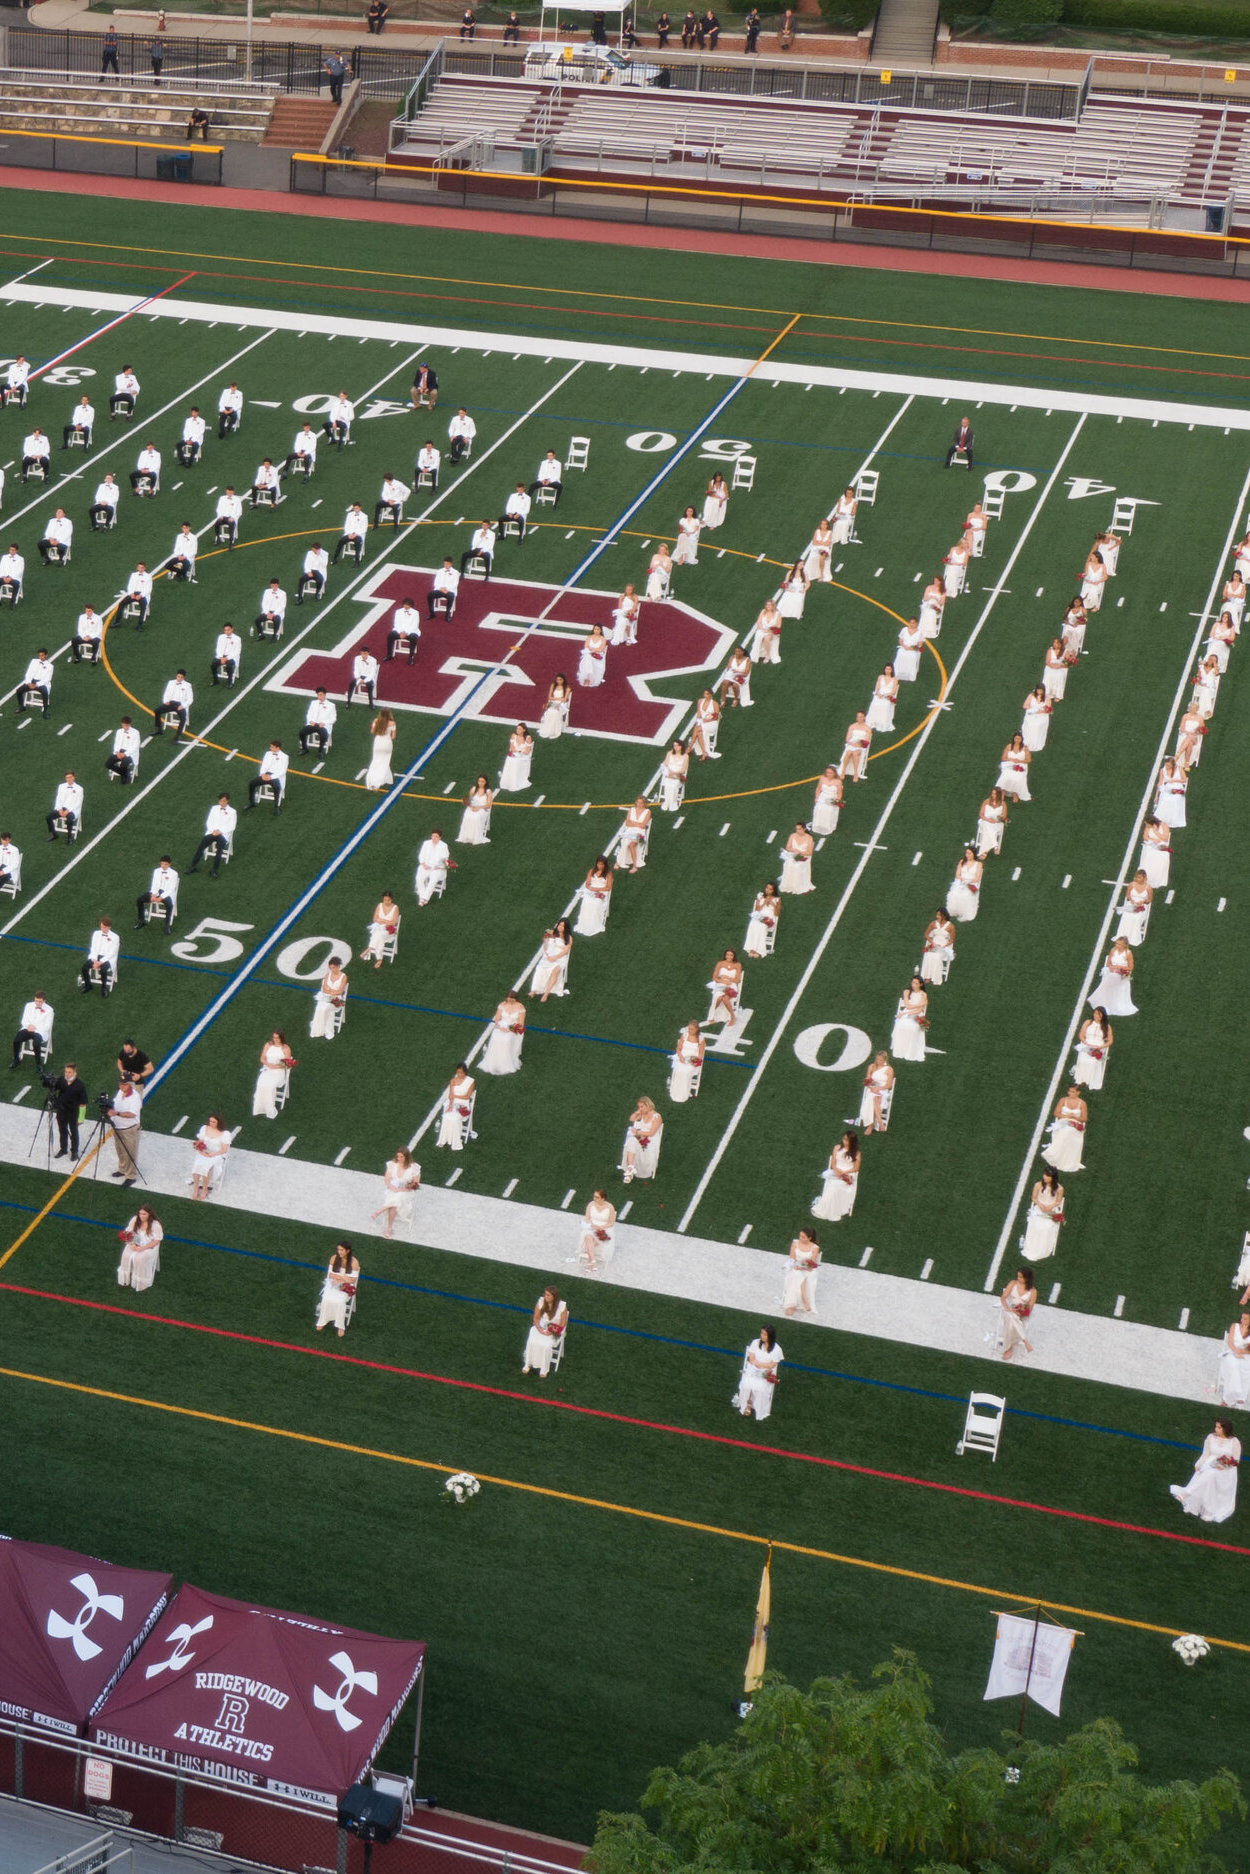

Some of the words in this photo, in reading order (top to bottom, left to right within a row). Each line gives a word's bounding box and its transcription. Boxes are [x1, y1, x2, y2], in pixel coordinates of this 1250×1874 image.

[562, 74, 594, 83] POLI
[262, 563, 738, 747] R
[195, 1672, 290, 1710] RIDGEWOOD
[214, 1693, 250, 1734] R
[96, 1729, 171, 1762] PROTECT
[173, 1752, 201, 1773] THIS
[173, 1722, 274, 1762] ATHLETICS
[87, 1770, 109, 1780] DOGS
